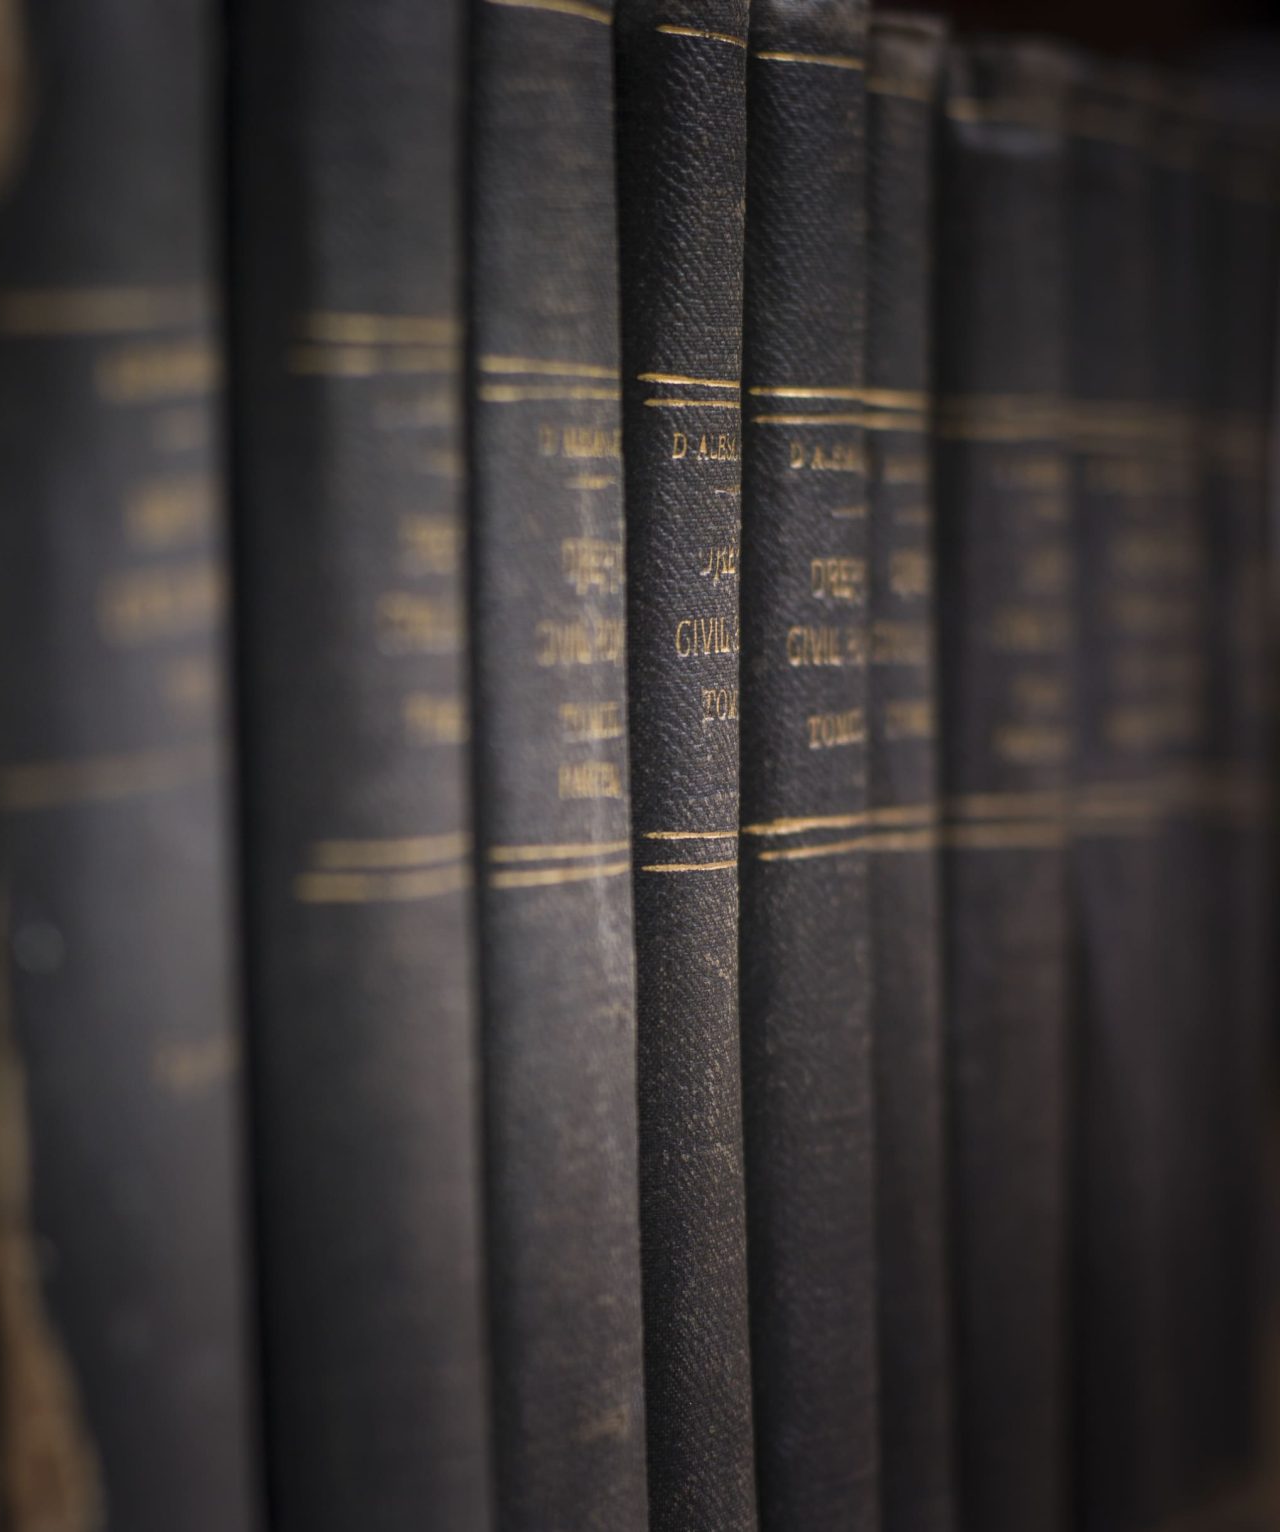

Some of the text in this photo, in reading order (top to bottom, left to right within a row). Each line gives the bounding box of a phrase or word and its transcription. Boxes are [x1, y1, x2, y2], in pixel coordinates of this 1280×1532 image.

[672, 432, 688, 460] D
[789, 442, 804, 469] D
[675, 616, 730, 659] CIVIL
[786, 624, 843, 667] CIVIL
